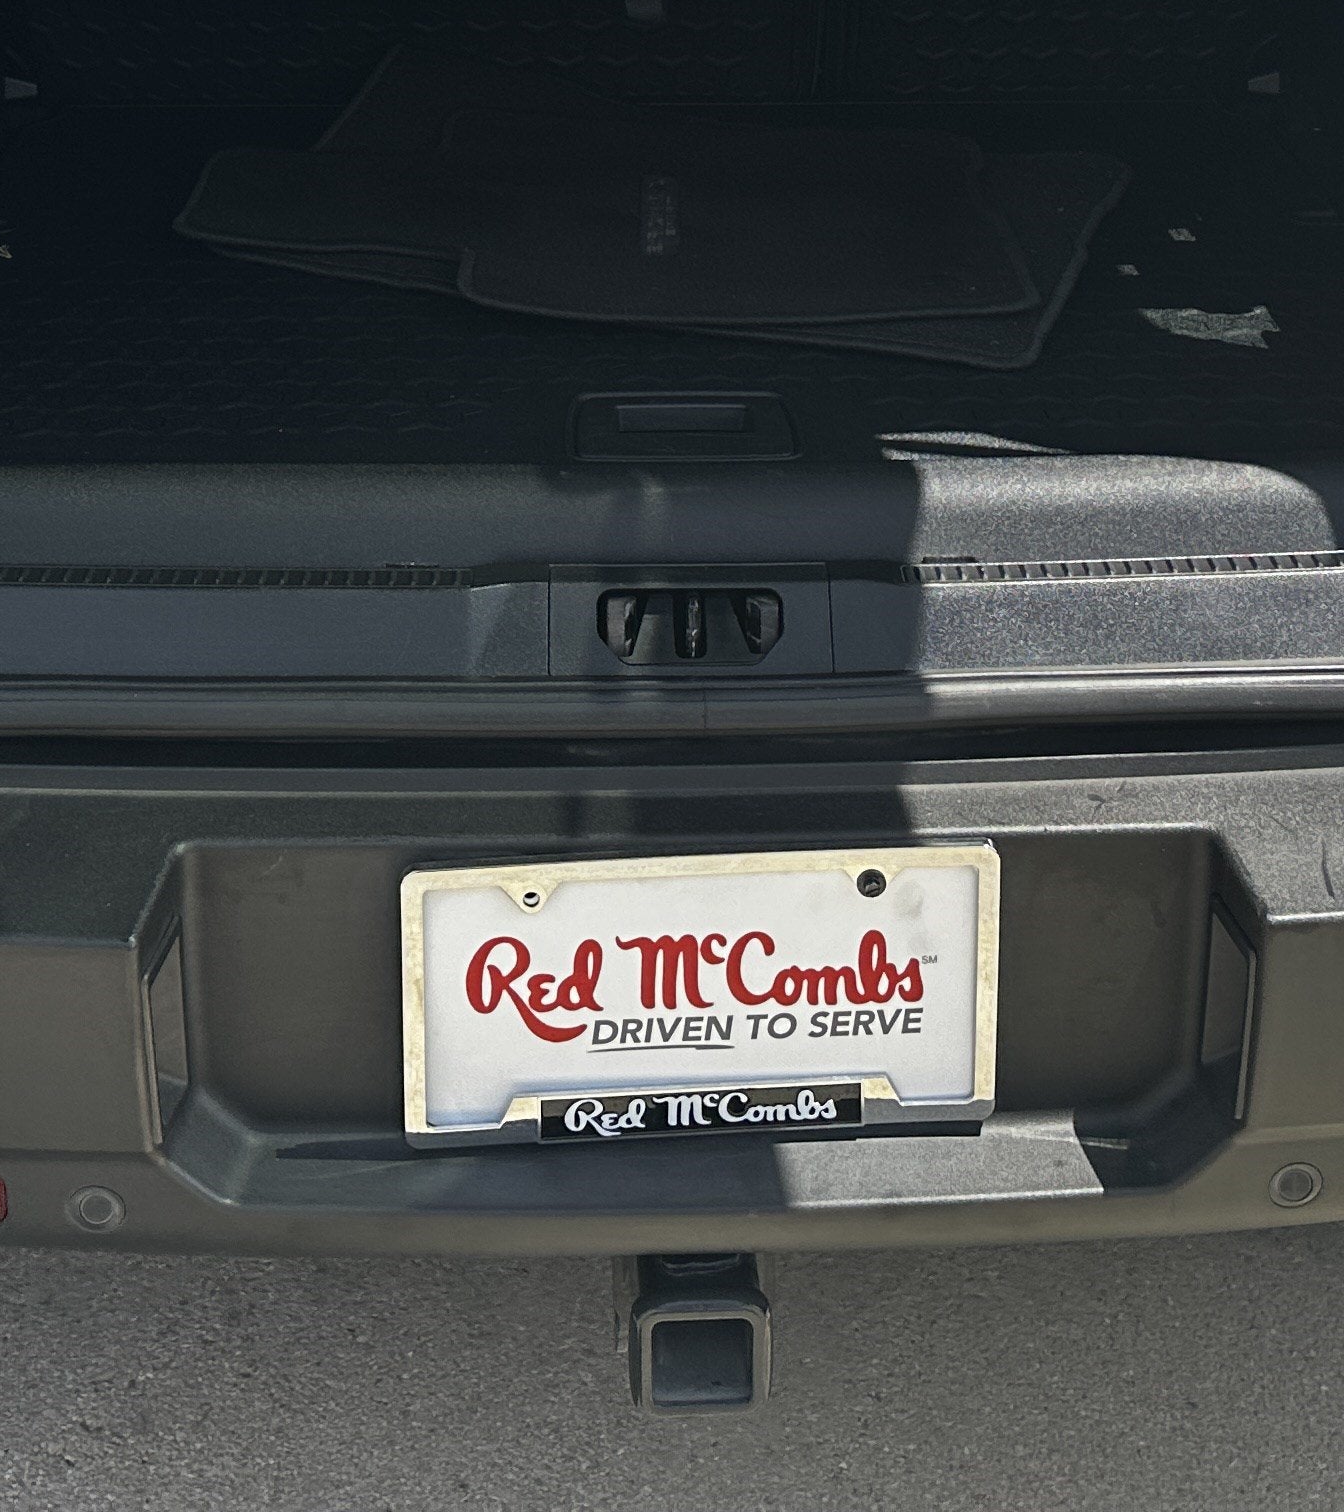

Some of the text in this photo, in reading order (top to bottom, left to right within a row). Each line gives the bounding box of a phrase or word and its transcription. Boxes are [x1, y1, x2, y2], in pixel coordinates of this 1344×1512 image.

[465, 936, 604, 1043] Red
[615, 929, 924, 1010] McCombs
[590, 1007, 925, 1046] DRIVEN TO SERVE
[564, 1089, 838, 1136] Red McCombs
